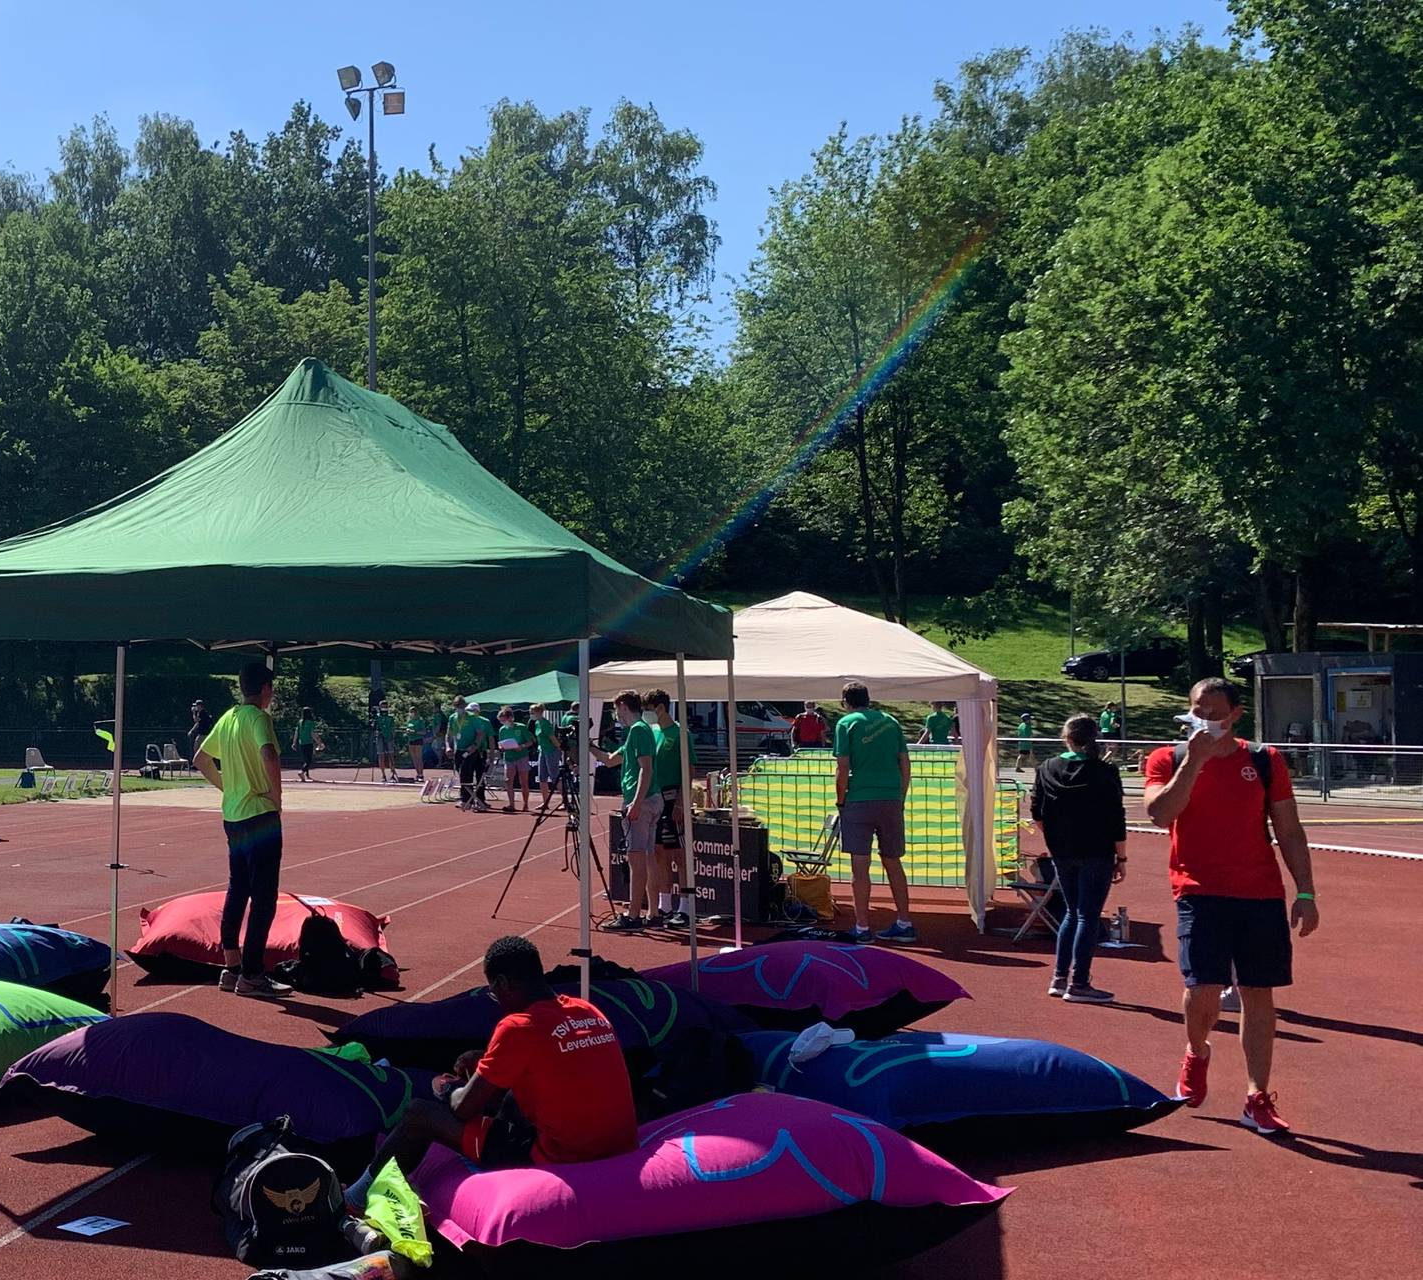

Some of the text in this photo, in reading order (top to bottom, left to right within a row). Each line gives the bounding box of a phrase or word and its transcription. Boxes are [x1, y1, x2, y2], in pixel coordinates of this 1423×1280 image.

[551, 1021, 571, 1039] TSV
[569, 1017, 597, 1030] Bayer
[558, 1033, 615, 1052] Leverkusen
[286, 1246, 306, 1254] JAKO
